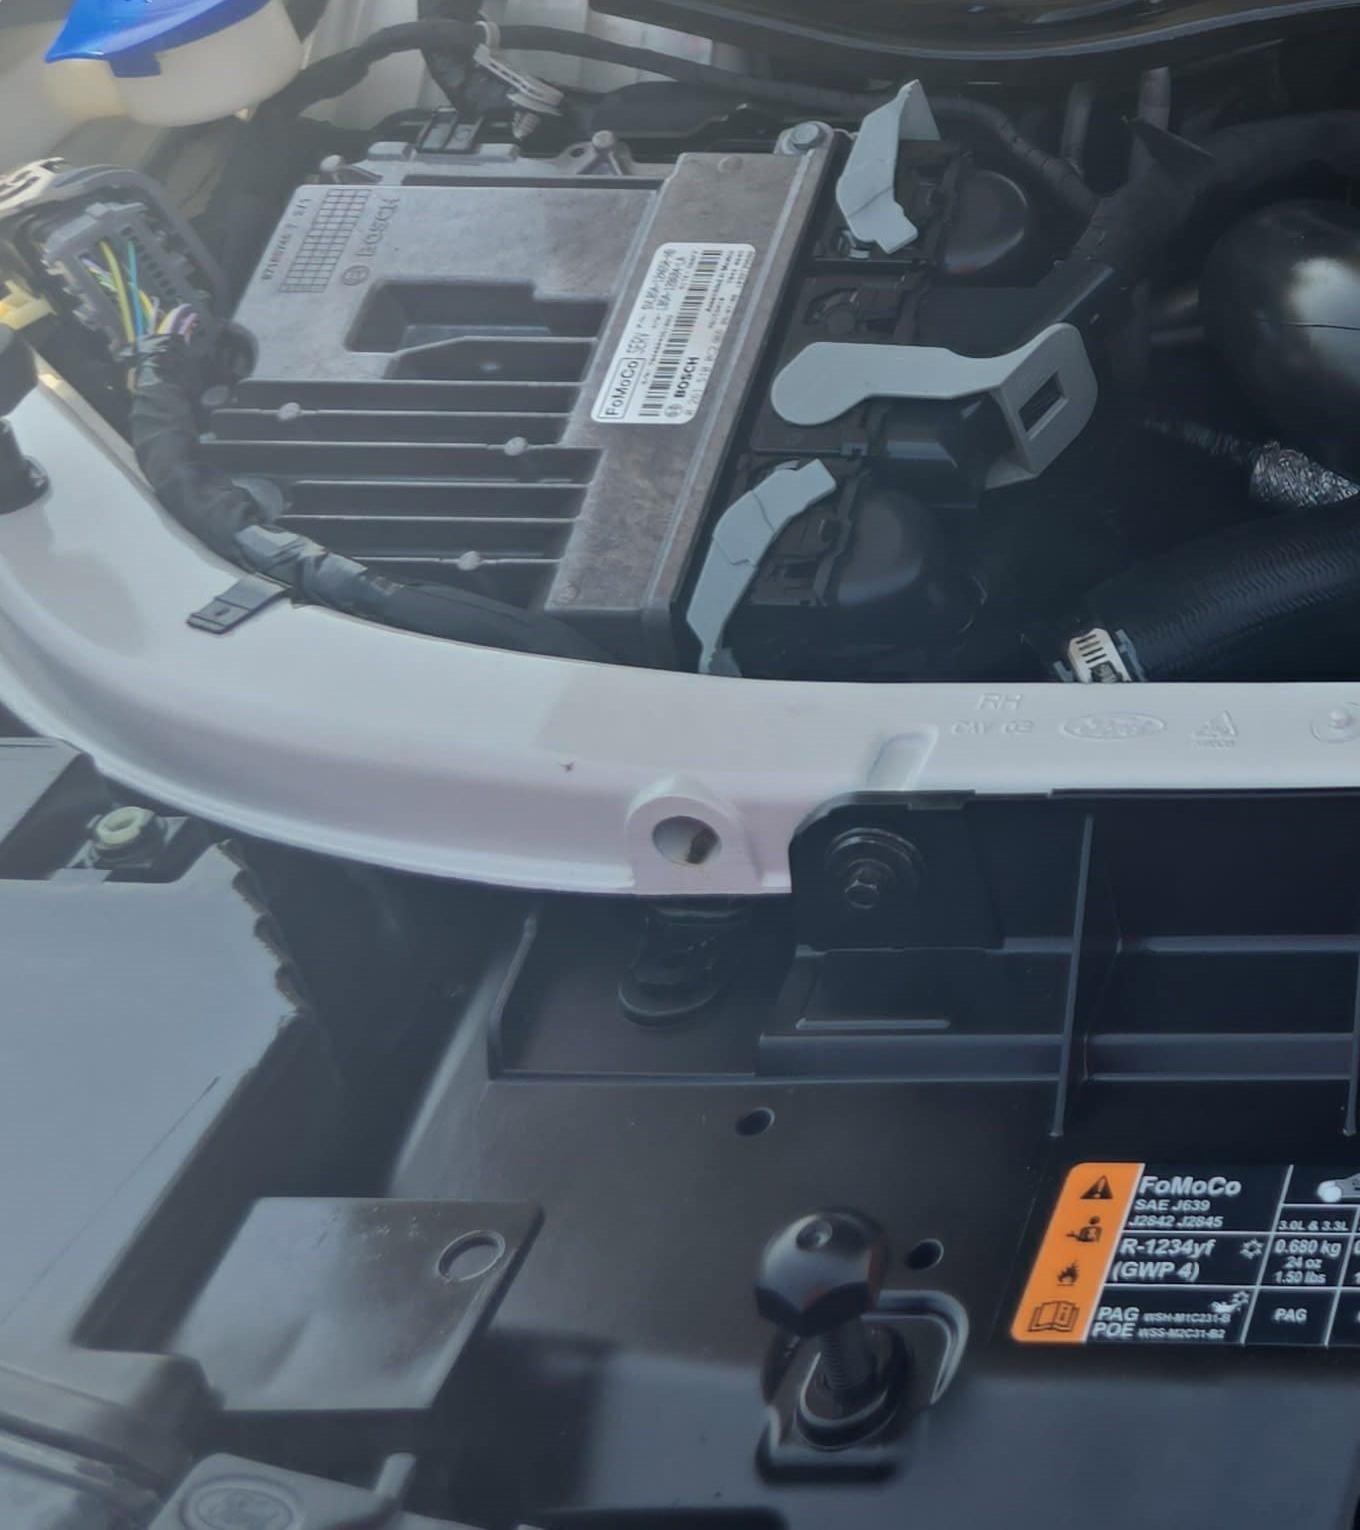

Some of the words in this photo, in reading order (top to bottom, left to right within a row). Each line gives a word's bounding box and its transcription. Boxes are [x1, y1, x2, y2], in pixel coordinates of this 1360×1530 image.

[673, 356, 699, 398] BOSCH
[605, 360, 639, 416] FoMoCo
[977, 692, 1023, 711] RH
[1138, 1175, 1242, 1197] FoMoCo
[1134, 1198, 1170, 1212] SAE
[1172, 1199, 1211, 1212] J639
[1278, 1220, 1306, 1231] 3.0L
[1307, 1220, 1319, 1231] &
[1321, 1220, 1349, 1232] 3.3L
[1119, 1237, 1217, 1259] R-1234yf
[1273, 1238, 1319, 1255] 0.680
[1320, 1239, 1342, 1258] kg
[1112, 1261, 1175, 1281] (GWP
[1177, 1261, 1200, 1282] 4)
[1283, 1256, 1304, 1269] 24
[1304, 1258, 1323, 1269] oz
[1273, 1271, 1303, 1284] 1.50
[1304, 1271, 1327, 1284] lbs
[1097, 1306, 1140, 1322] PAG
[1273, 1308, 1308, 1322] PAG
[1091, 1322, 1136, 1339] POE
